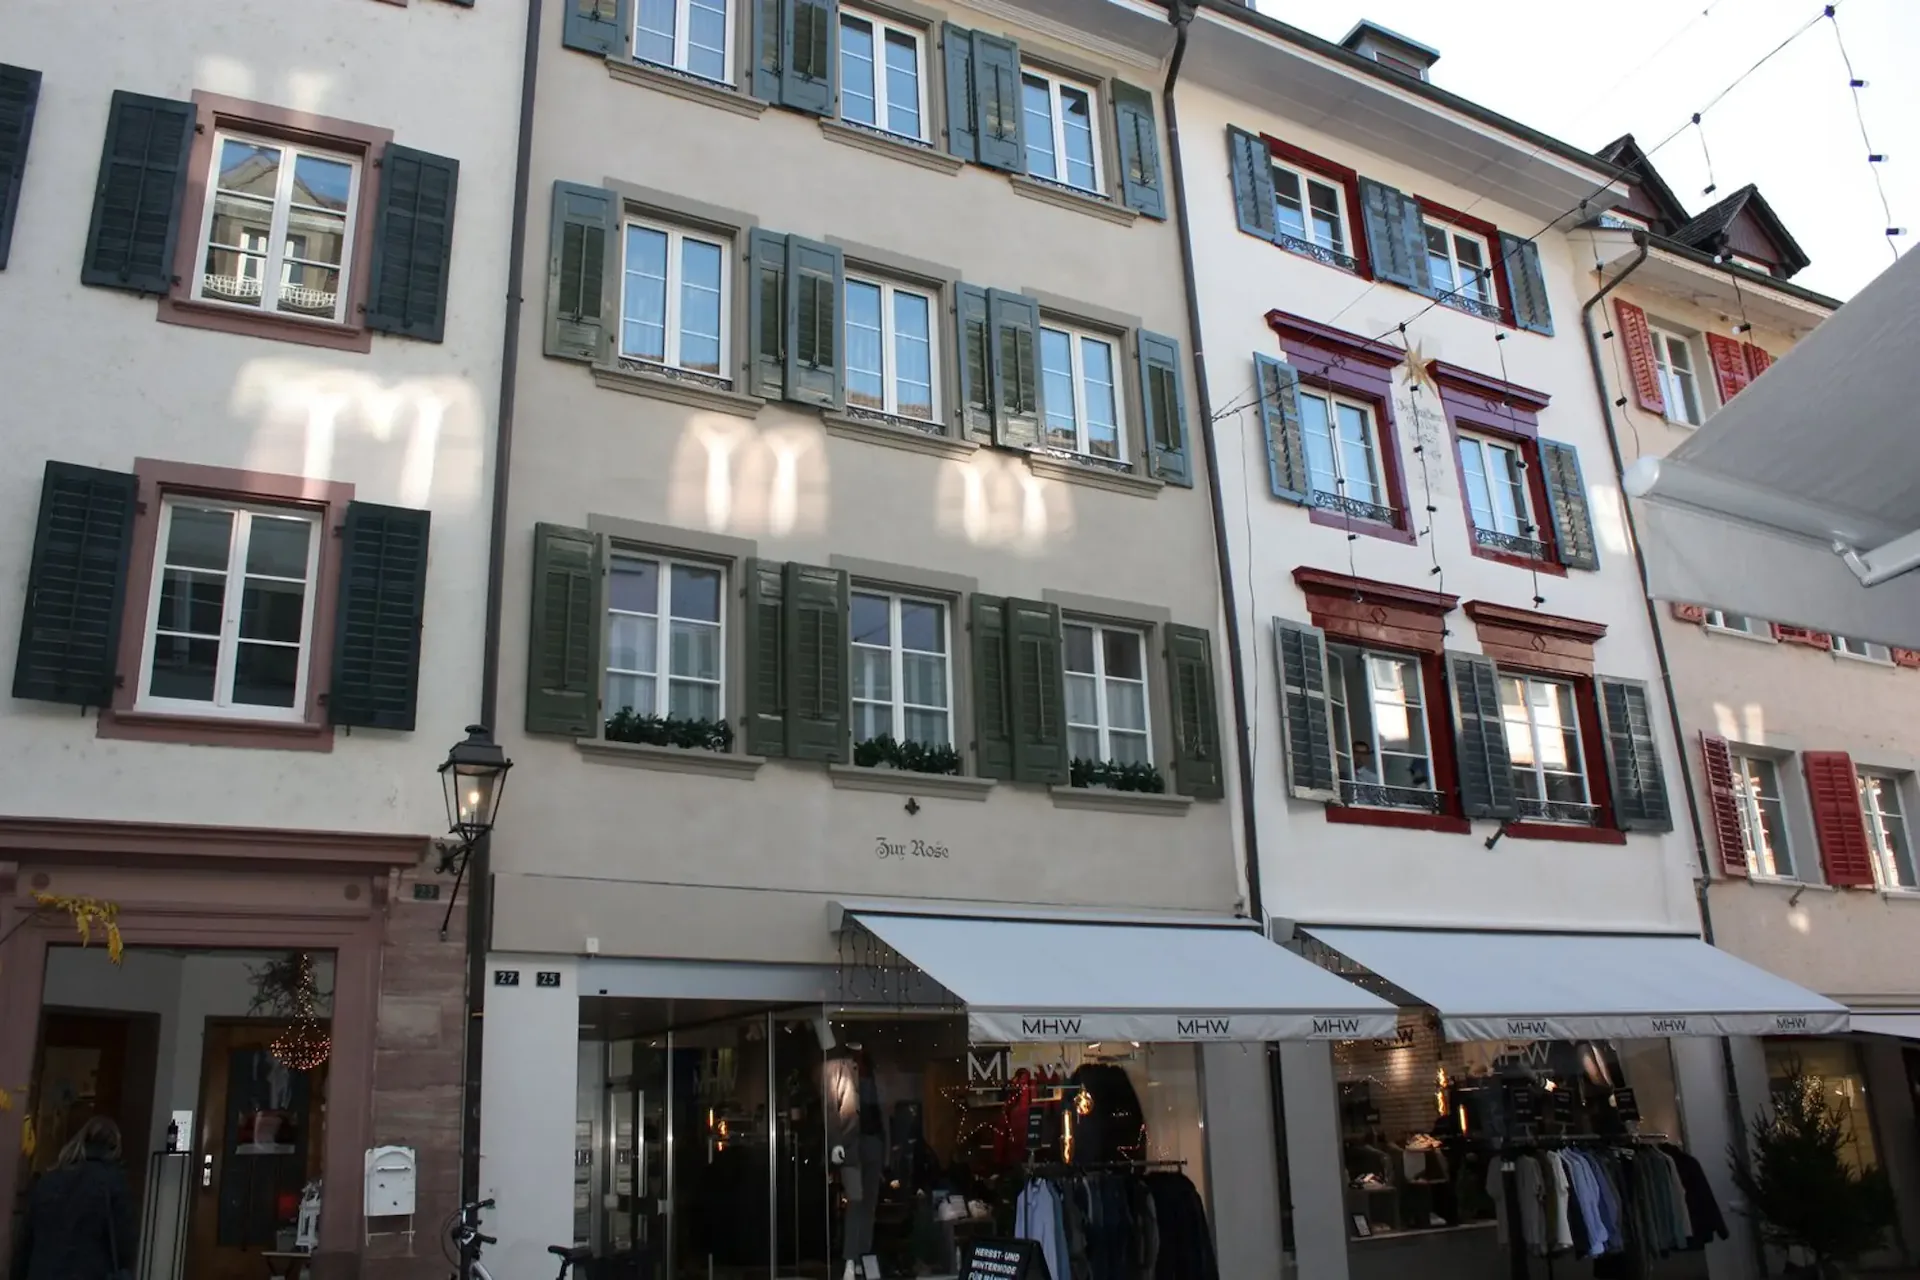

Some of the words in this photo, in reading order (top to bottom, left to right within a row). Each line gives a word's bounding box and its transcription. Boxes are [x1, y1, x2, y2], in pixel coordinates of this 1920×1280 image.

[876, 837, 906, 860] Zur
[911, 839, 949, 858] Rose
[499, 972, 515, 984] 27
[541, 973, 556, 985] 25
[1022, 1019, 1081, 1035] MHW
[1177, 1019, 1229, 1035] MHW
[1313, 1019, 1359, 1034] MHW
[1507, 1021, 1546, 1035] MHW
[1652, 1019, 1687, 1032] MHW
[1776, 1016, 1807, 1029] MHW
[967, 1051, 1079, 1081] MHW
